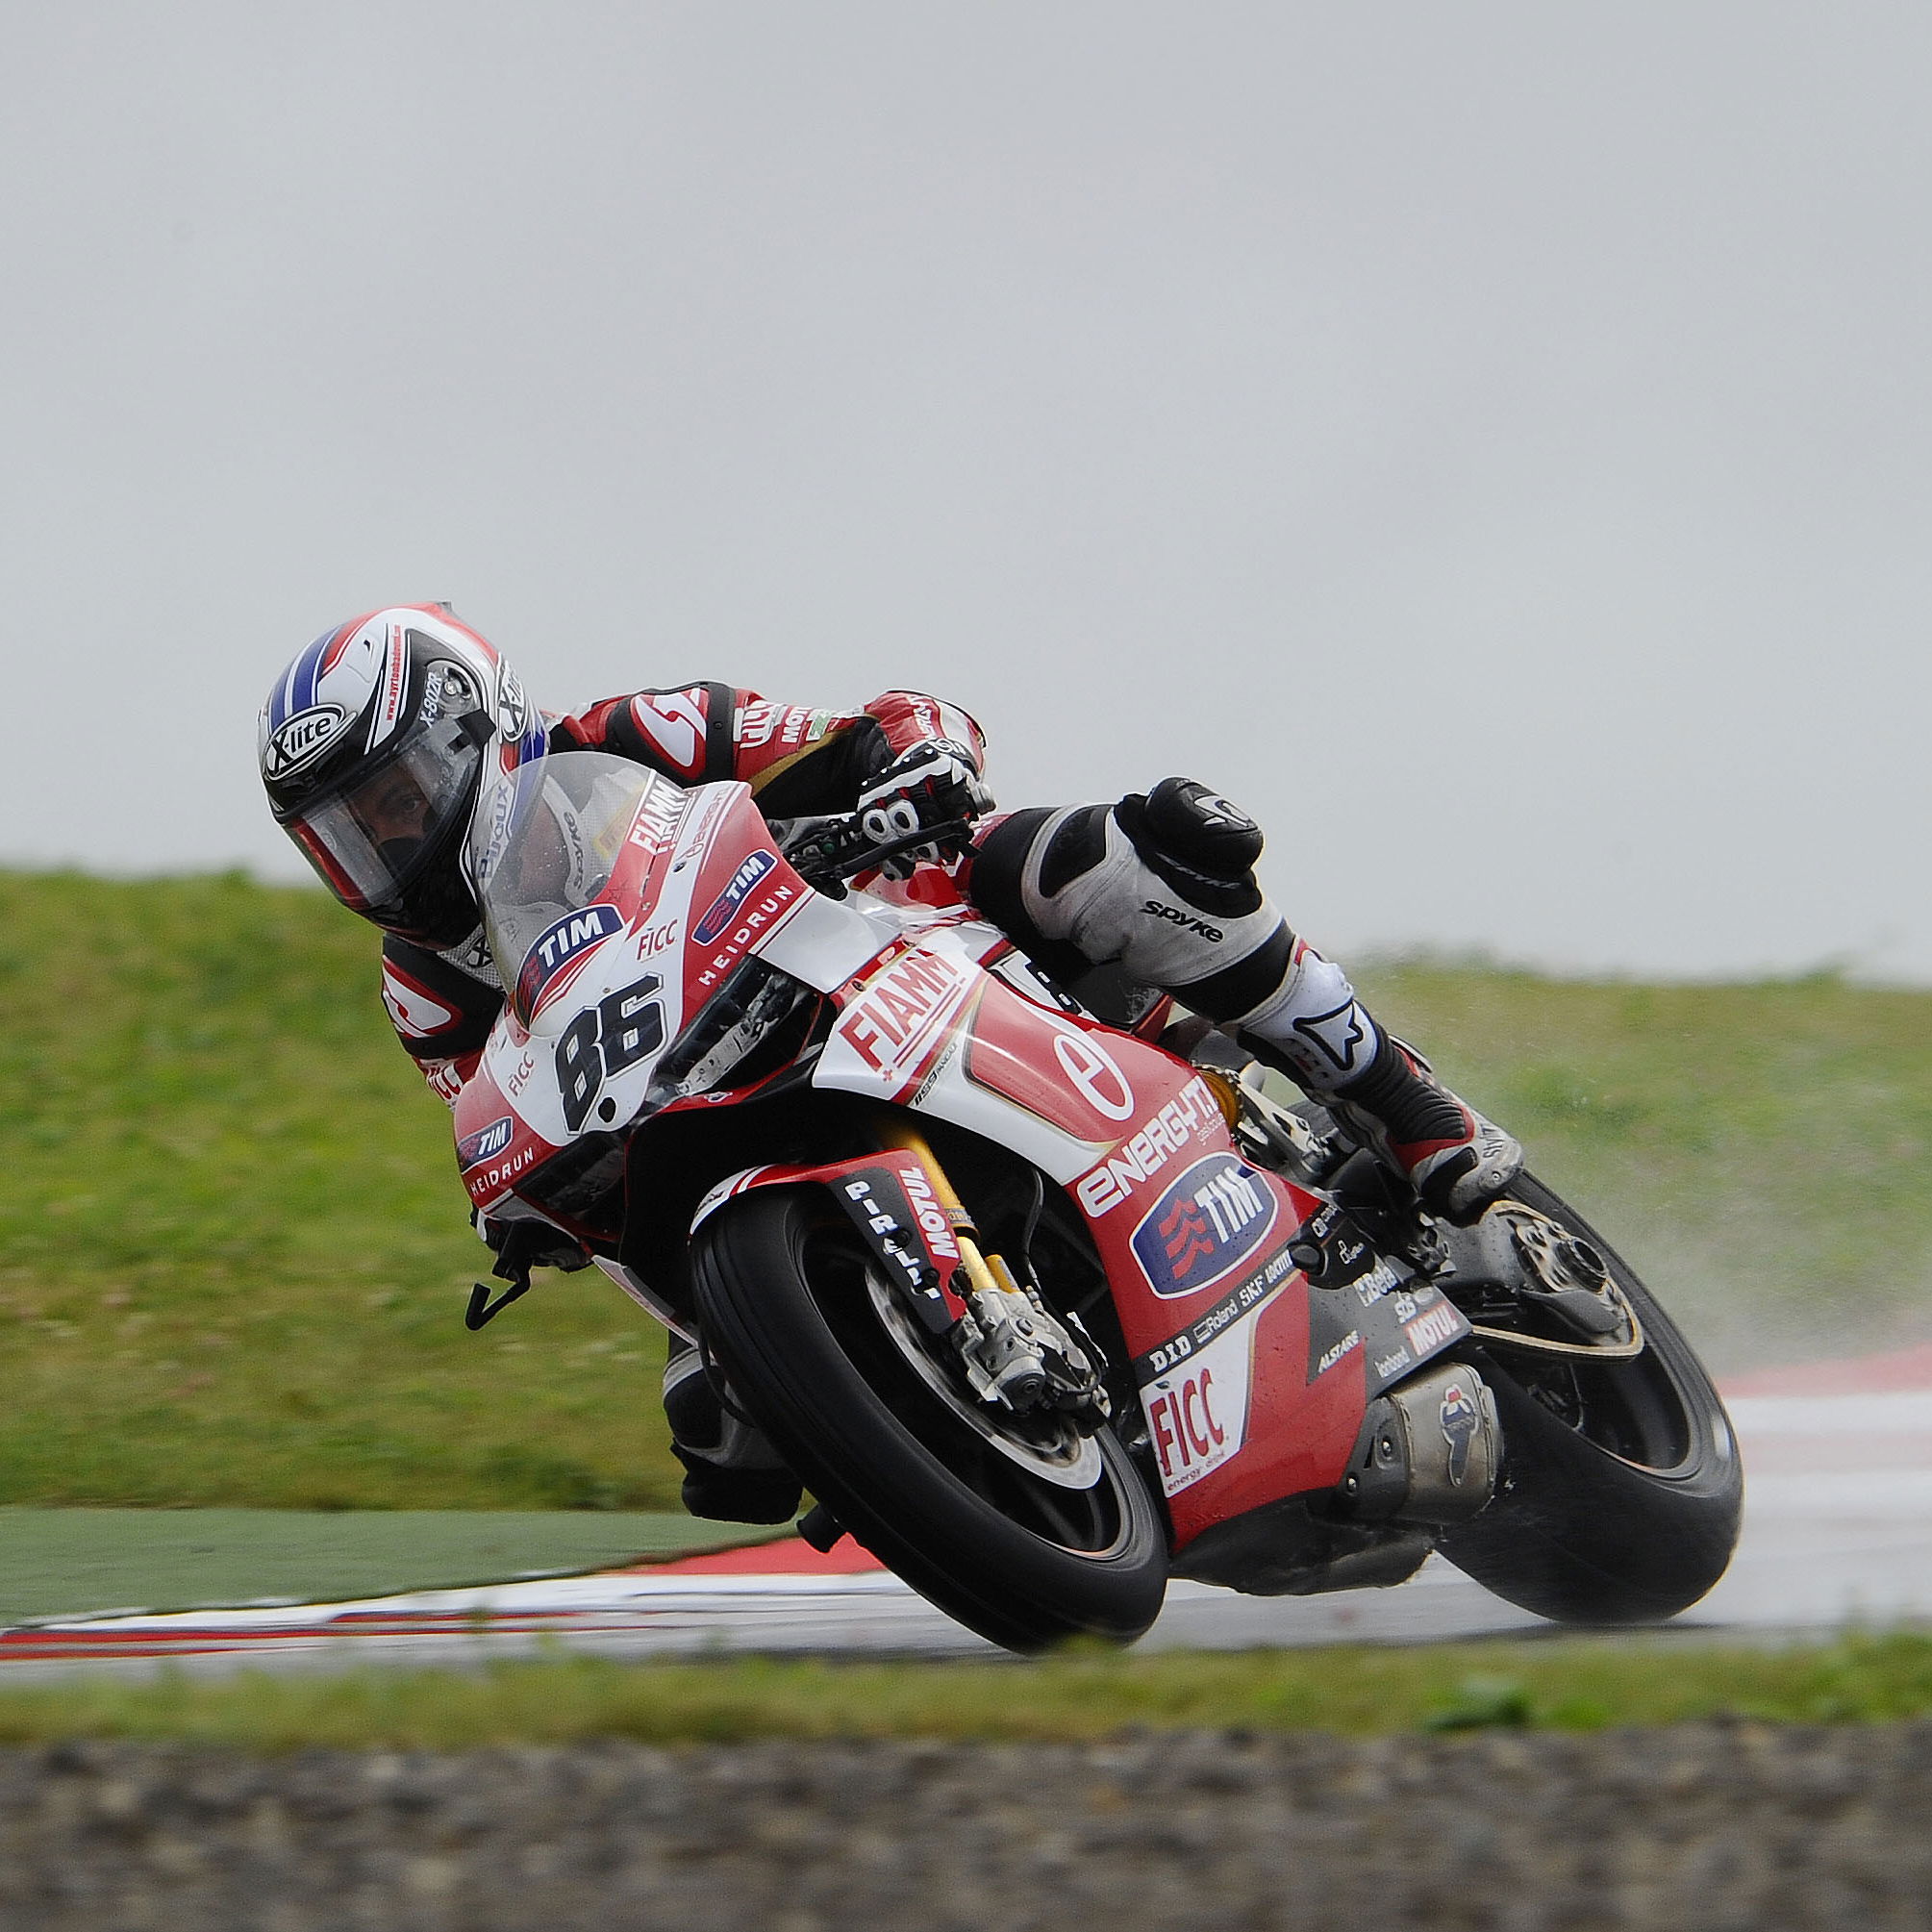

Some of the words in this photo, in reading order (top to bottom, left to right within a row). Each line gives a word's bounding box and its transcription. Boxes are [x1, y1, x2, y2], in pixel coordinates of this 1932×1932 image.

[420, 672, 442, 728] X-802R
[271, 717, 331, 775] X-lite
[726, 857, 765, 901] TIM
[539, 912, 603, 967] TIM
[637, 919, 678, 961] FICC
[698, 885, 793, 985] HEIDRUN
[839, 949, 958, 1072] FIAMM
[508, 1051, 535, 1097] FICC
[555, 971, 665, 1135] 86
[478, 1121, 508, 1155] TIM
[470, 1146, 535, 1196] HEIDRUN
[899, 1167, 960, 1259] MOTUL
[1193, 1166, 1265, 1243] TIM
[1238, 1274, 1264, 1308] SKF
[1408, 1304, 1460, 1356] MOTUL
[1149, 1368, 1224, 1477] FICC
